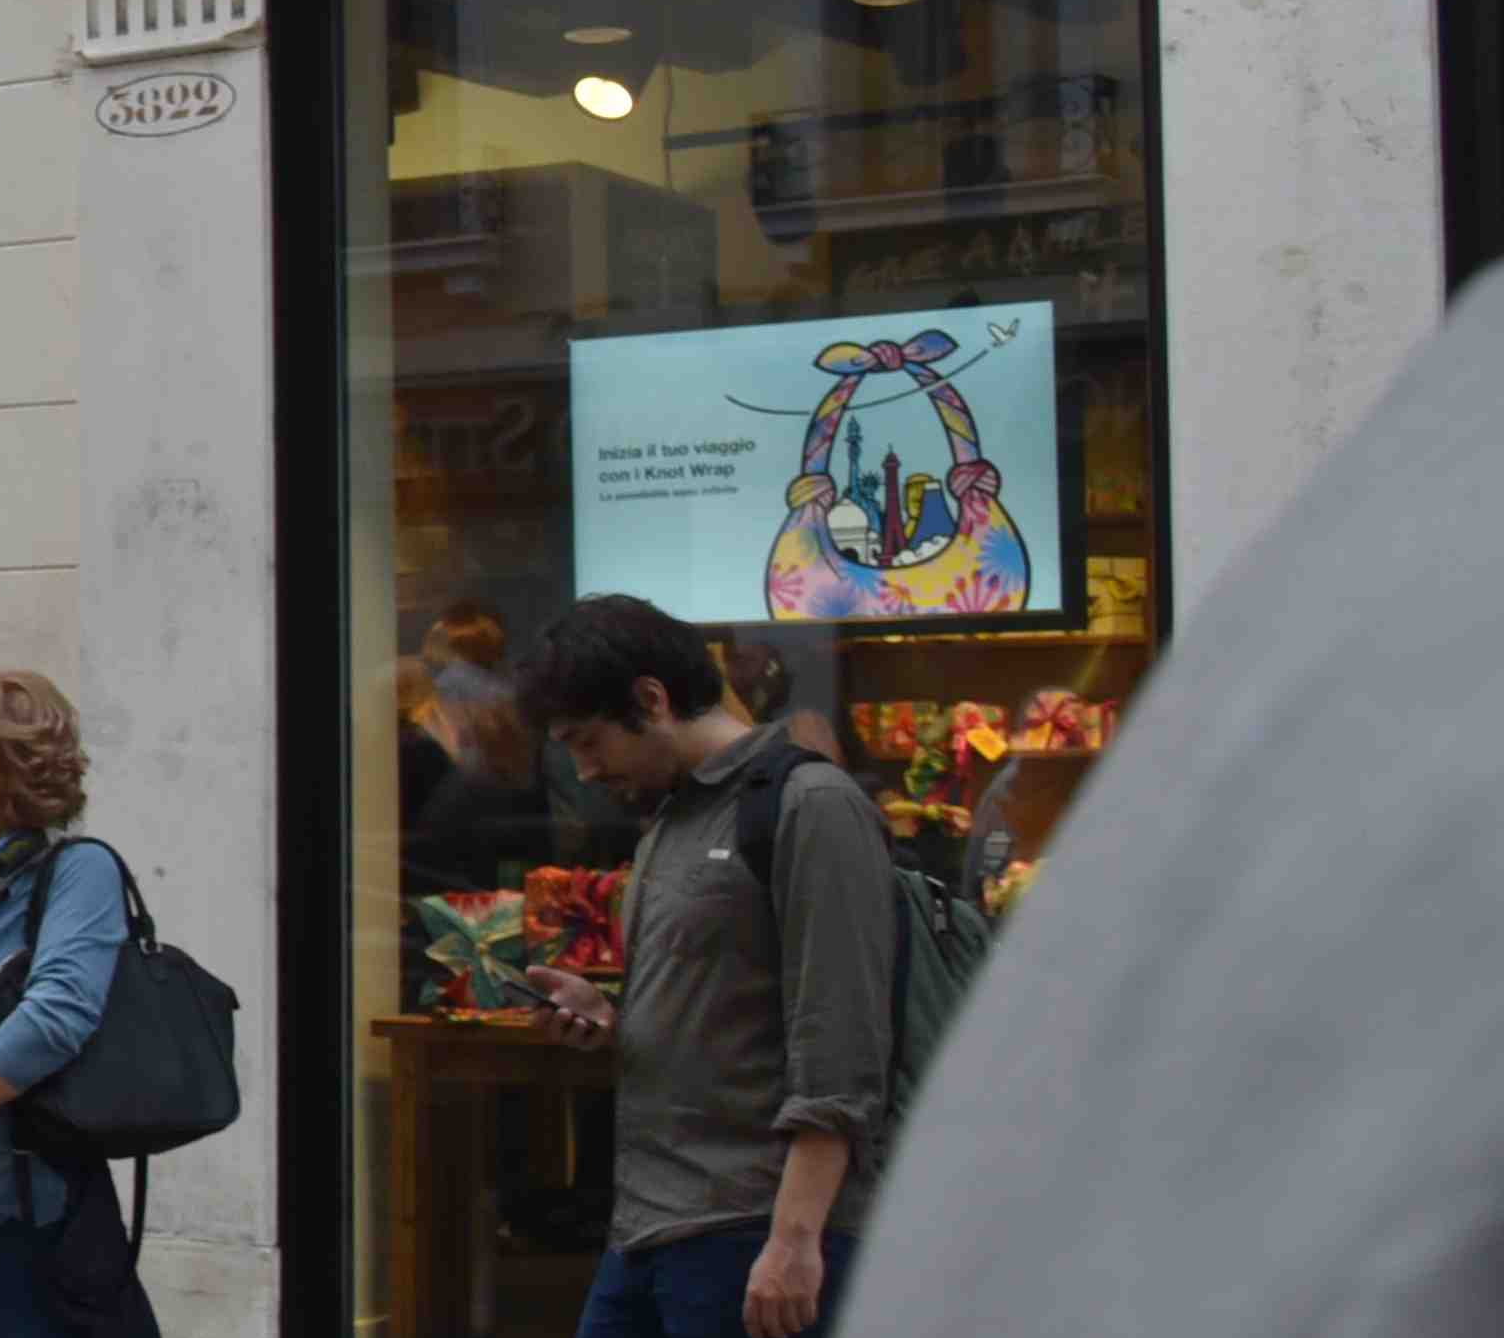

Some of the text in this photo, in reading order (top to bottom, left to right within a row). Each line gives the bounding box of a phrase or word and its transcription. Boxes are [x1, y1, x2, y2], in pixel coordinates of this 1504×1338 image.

[109, 81, 219, 125] 5822
[598, 437, 756, 461] Inizia il tuo viaggio
[598, 470, 630, 483] con
[644, 465, 686, 481] Knot
[689, 462, 736, 479] Wrap
